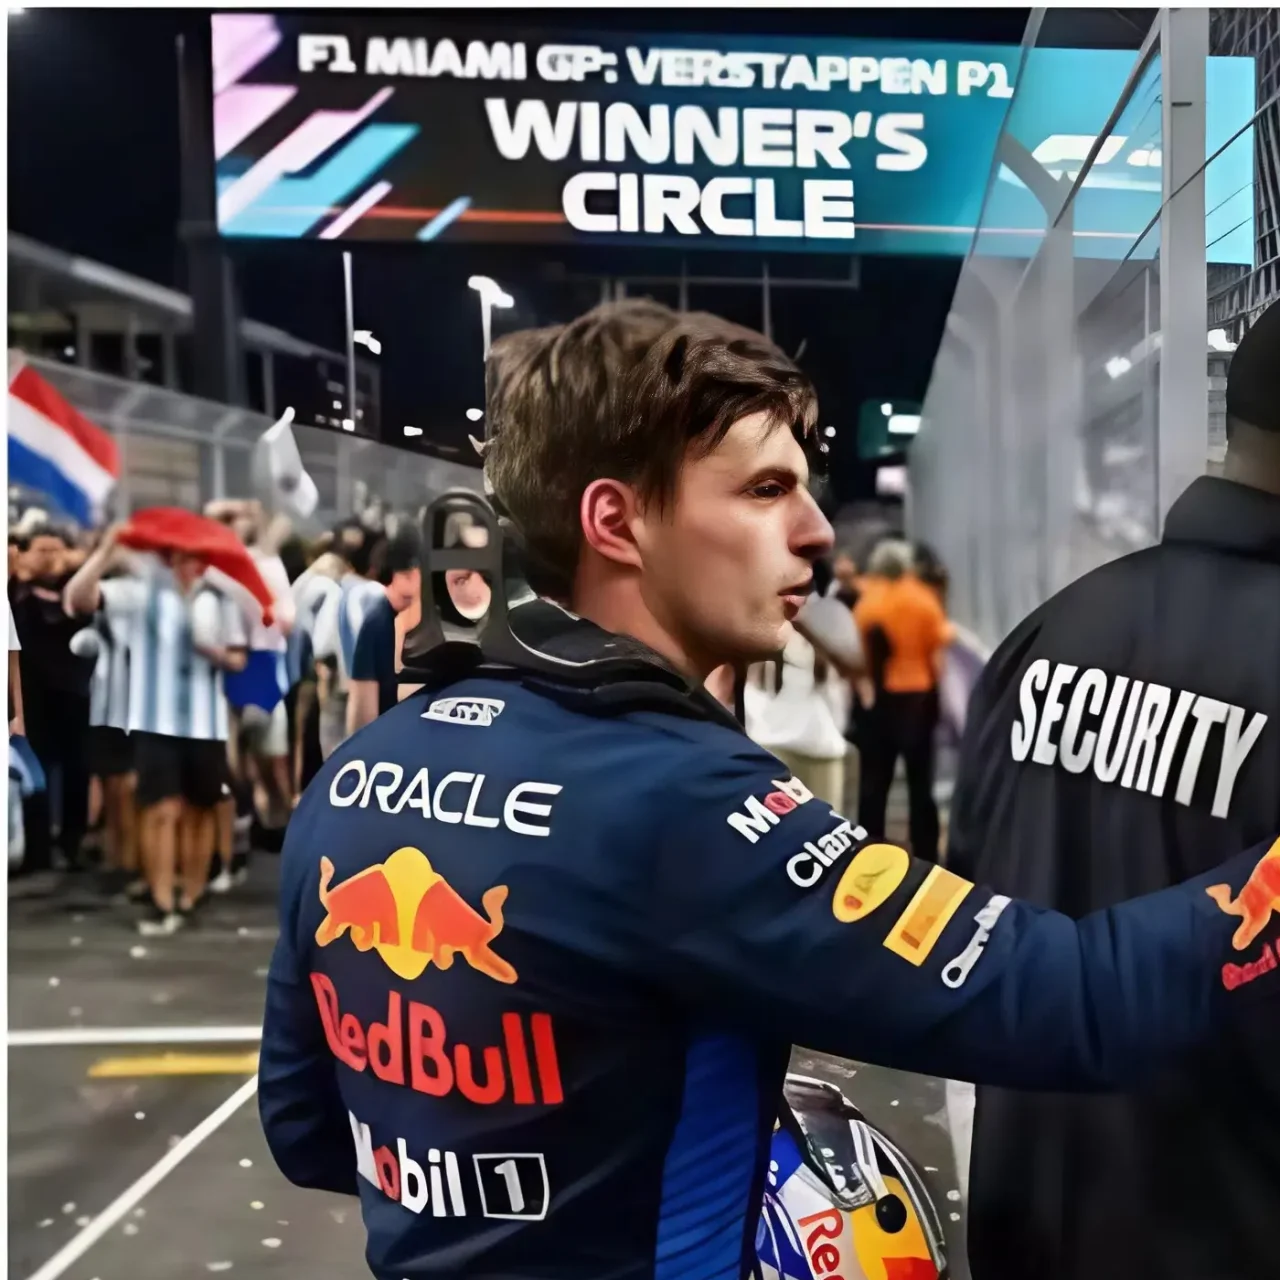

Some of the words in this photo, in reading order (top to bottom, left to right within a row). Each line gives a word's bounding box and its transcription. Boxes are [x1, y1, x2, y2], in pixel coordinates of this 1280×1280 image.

[298, 34, 356, 72] F1
[366, 38, 527, 80] MIAMI
[536, 44, 618, 83] GP:
[626, 46, 947, 95] VERSTAPPEN
[957, 61, 1014, 98] P1
[562, 171, 855, 239] CIRCLE
[1011, 658, 1268, 819] SECURITY
[329, 760, 563, 836] ORACLE
[348, 1109, 466, 1218] Mobil
